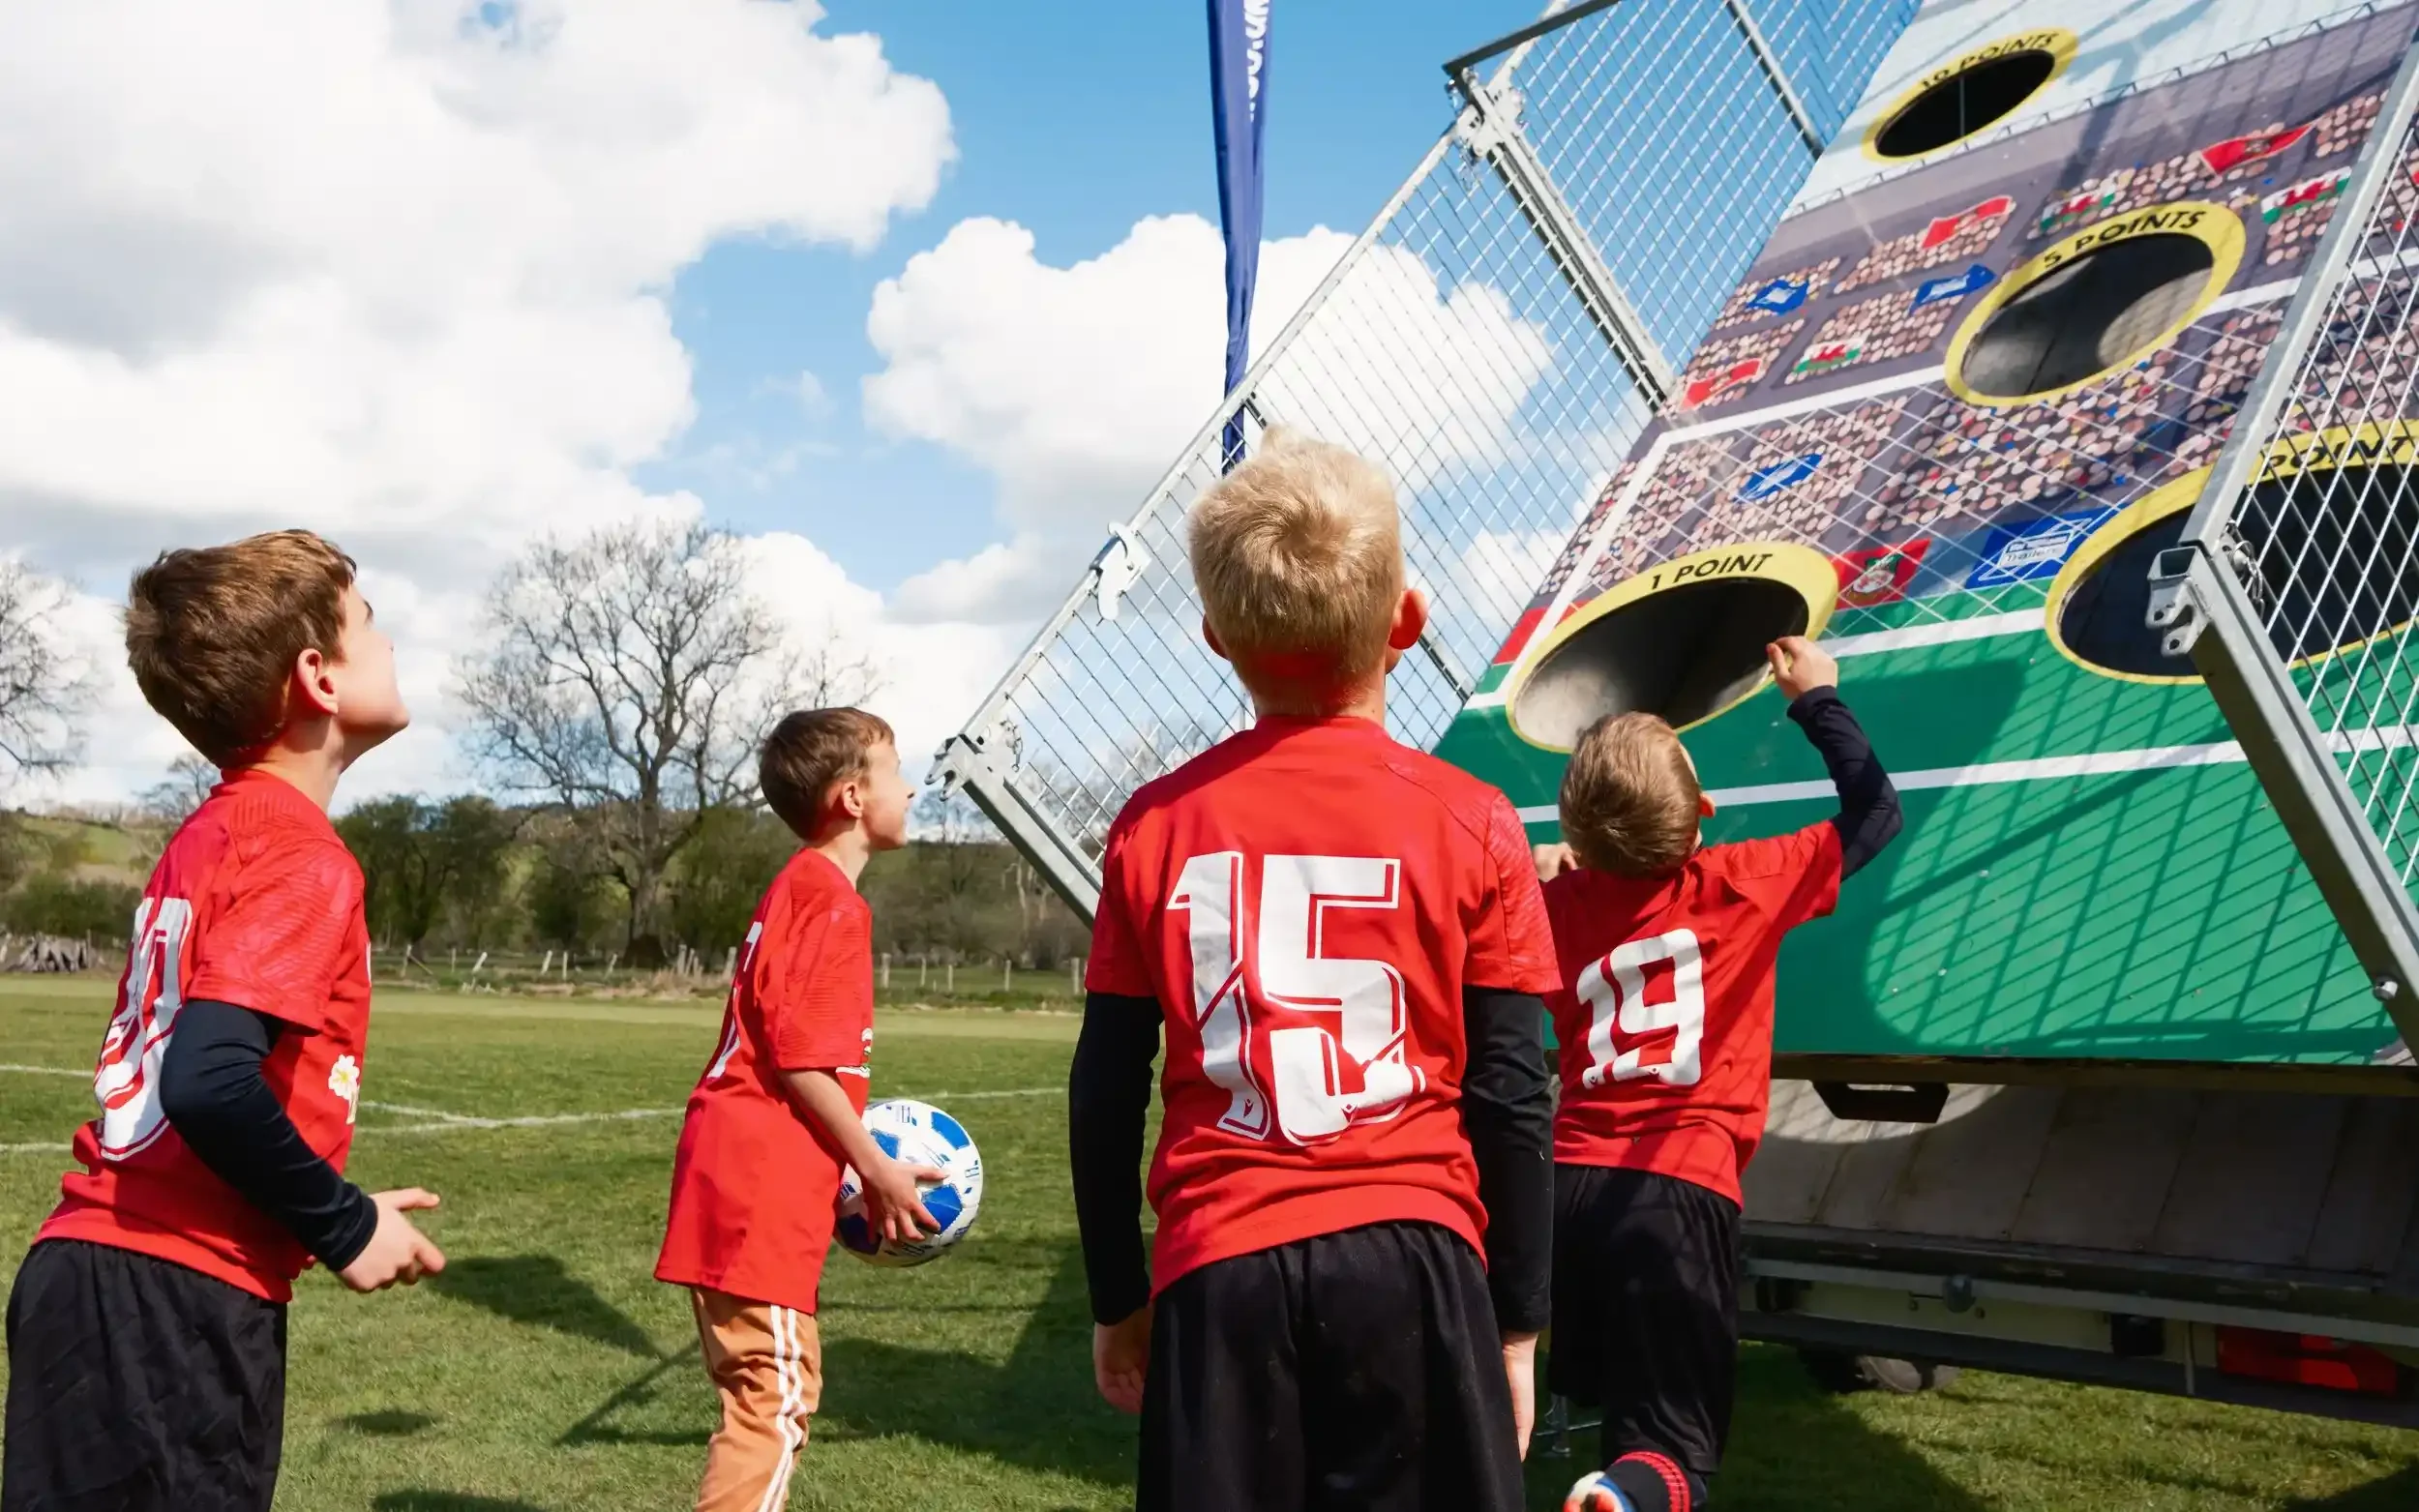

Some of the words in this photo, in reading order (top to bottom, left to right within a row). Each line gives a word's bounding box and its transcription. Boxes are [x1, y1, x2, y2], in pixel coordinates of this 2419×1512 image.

[1958, 31, 2059, 70] POINTS
[2044, 251, 2062, 269] 5
[2075, 211, 2206, 252] POINTS
[1651, 574, 1662, 590] 1
[1673, 553, 1774, 584] POINT
[1165, 850, 1427, 1146] 15
[1576, 928, 1705, 1090] 19
